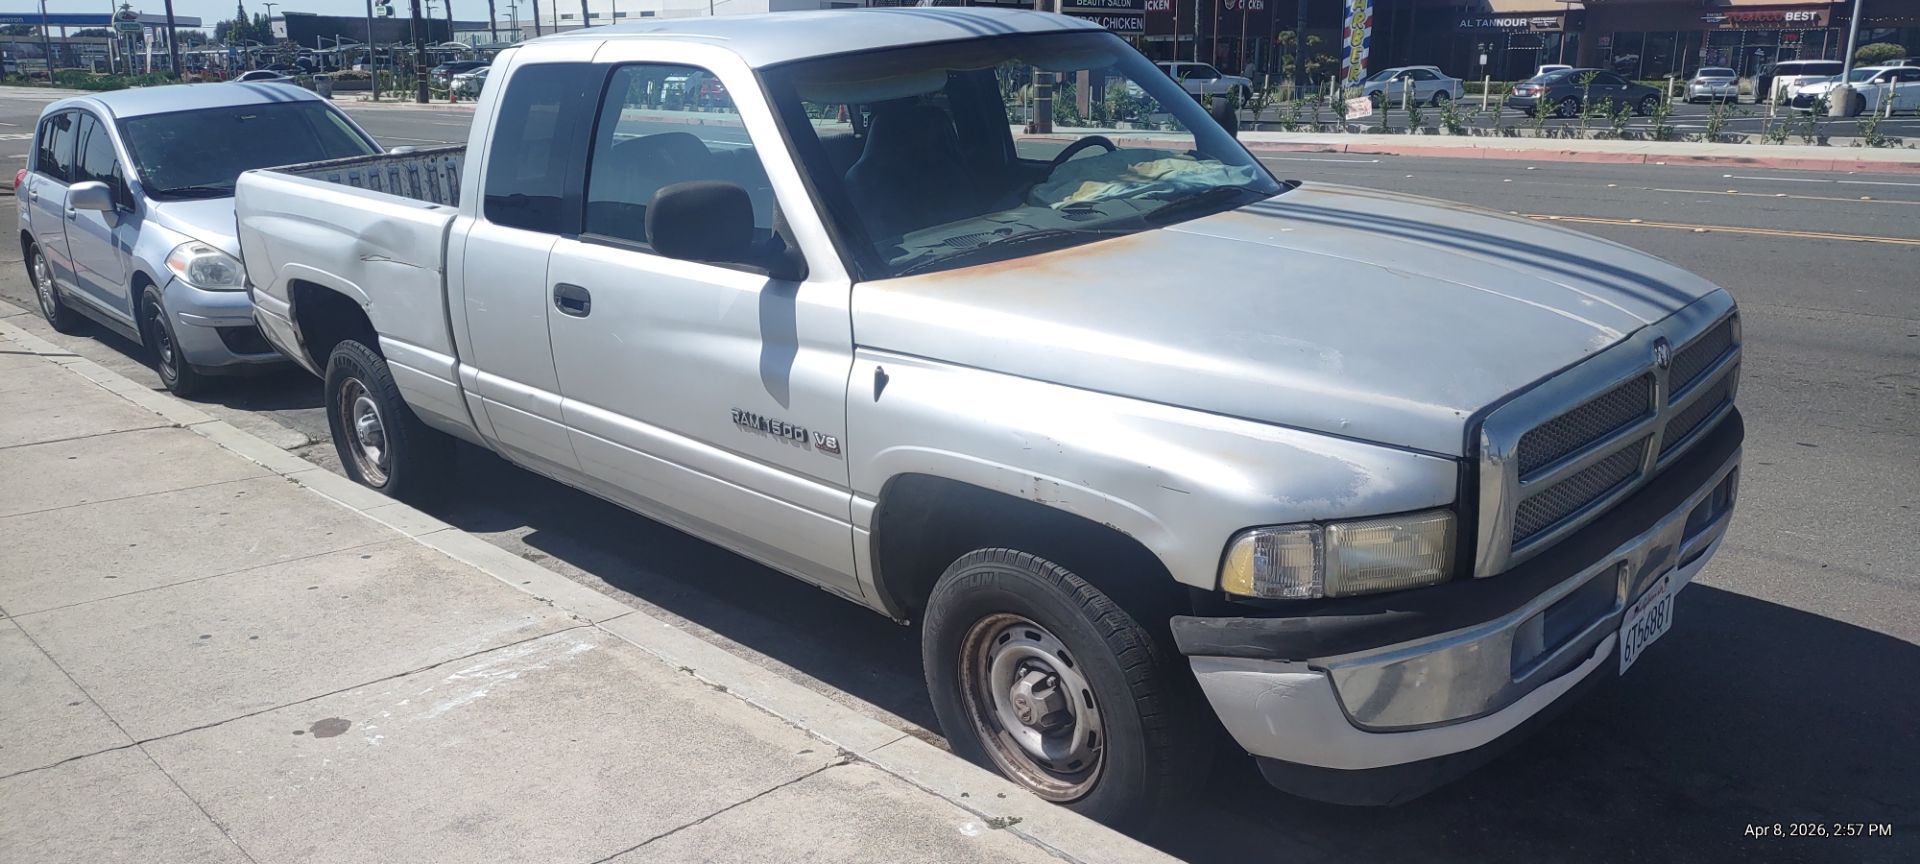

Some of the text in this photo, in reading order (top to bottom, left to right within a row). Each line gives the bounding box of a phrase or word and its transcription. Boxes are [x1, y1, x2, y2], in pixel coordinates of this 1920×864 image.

[1460, 19, 1474, 27] AL
[1476, 18, 1528, 27] TANNOUR
[1784, 11, 1817, 21] BEST
[1102, 17, 1144, 30] CHICKEN
[731, 408, 838, 449] RAM 1500 V8
[1624, 593, 1671, 662] 6T56887
